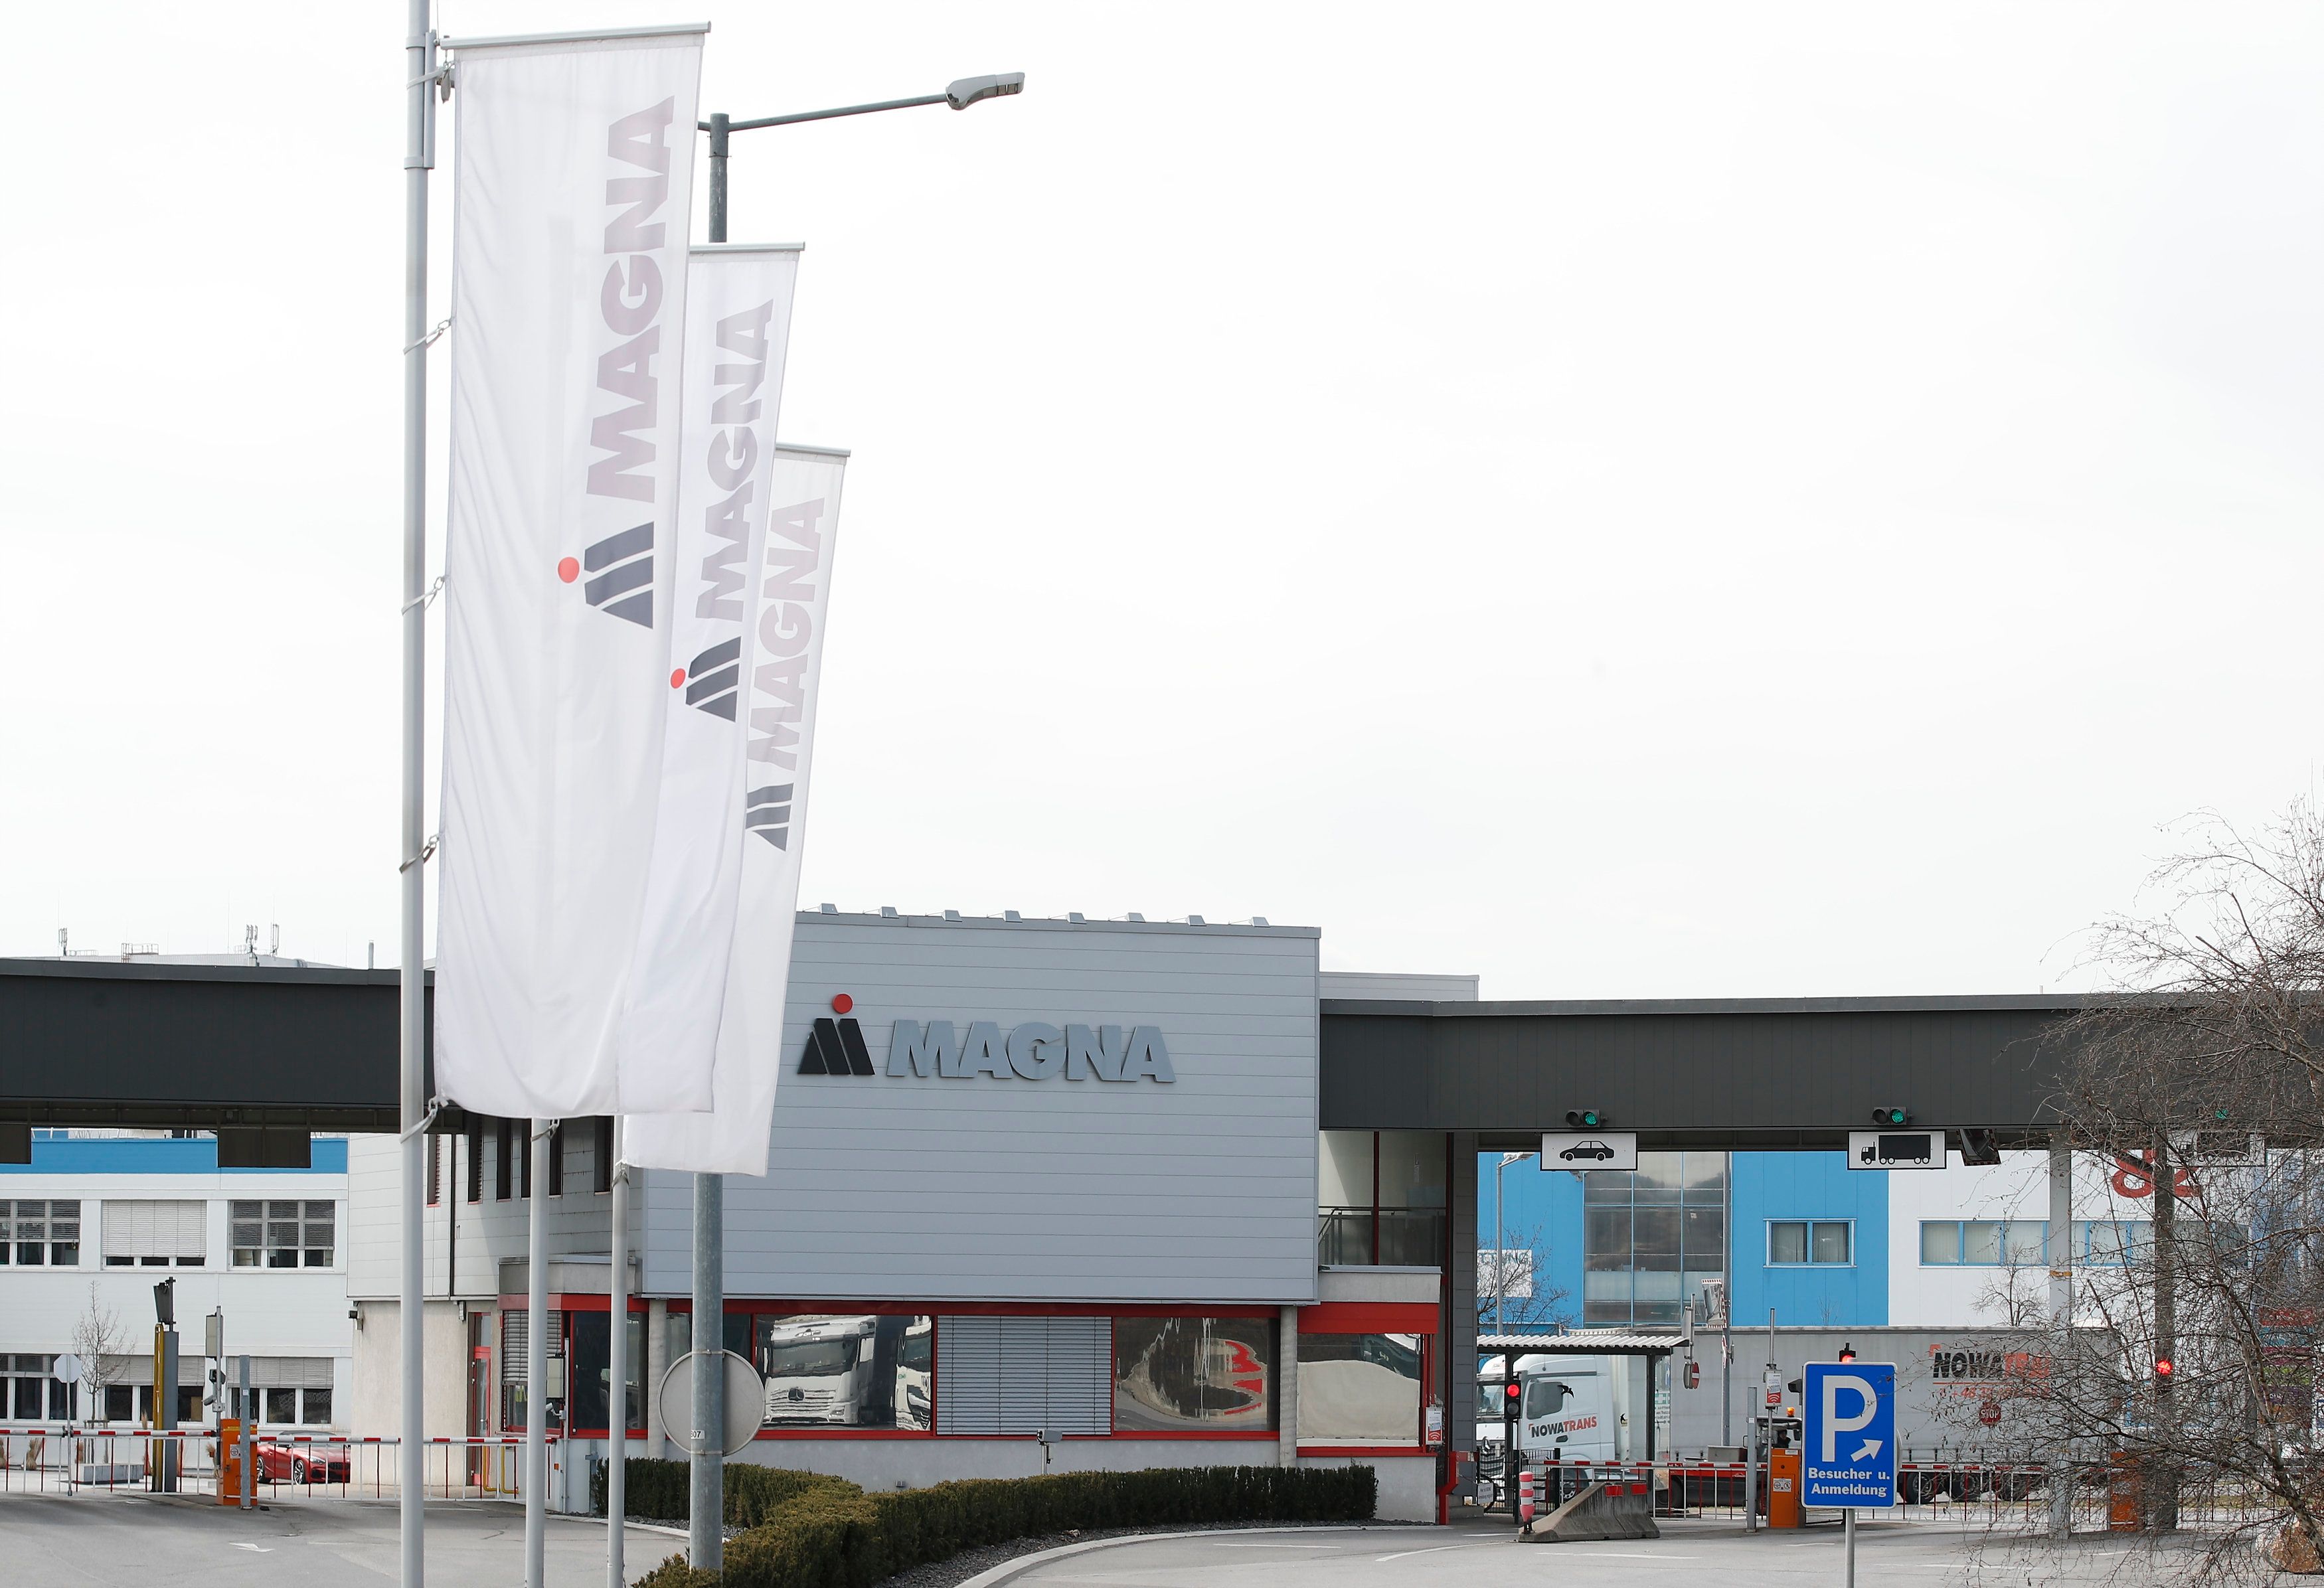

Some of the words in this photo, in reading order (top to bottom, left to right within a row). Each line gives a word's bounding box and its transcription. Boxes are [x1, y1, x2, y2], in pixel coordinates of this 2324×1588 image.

[586, 95, 675, 503] MAGNA
[695, 298, 774, 622] MAGNA
[747, 497, 825, 771] MAGNA
[886, 1019, 1177, 1083] MAGNA
[1531, 1416, 1598, 1438] NOWATRANS
[1822, 1375, 1878, 1463] P
[1981, 1408, 1999, 1419] STOP
[1808, 1467, 1872, 1480] Besucher
[1878, 1471, 1890, 1480] u.
[1811, 1482, 1887, 1498] Anmeldung
